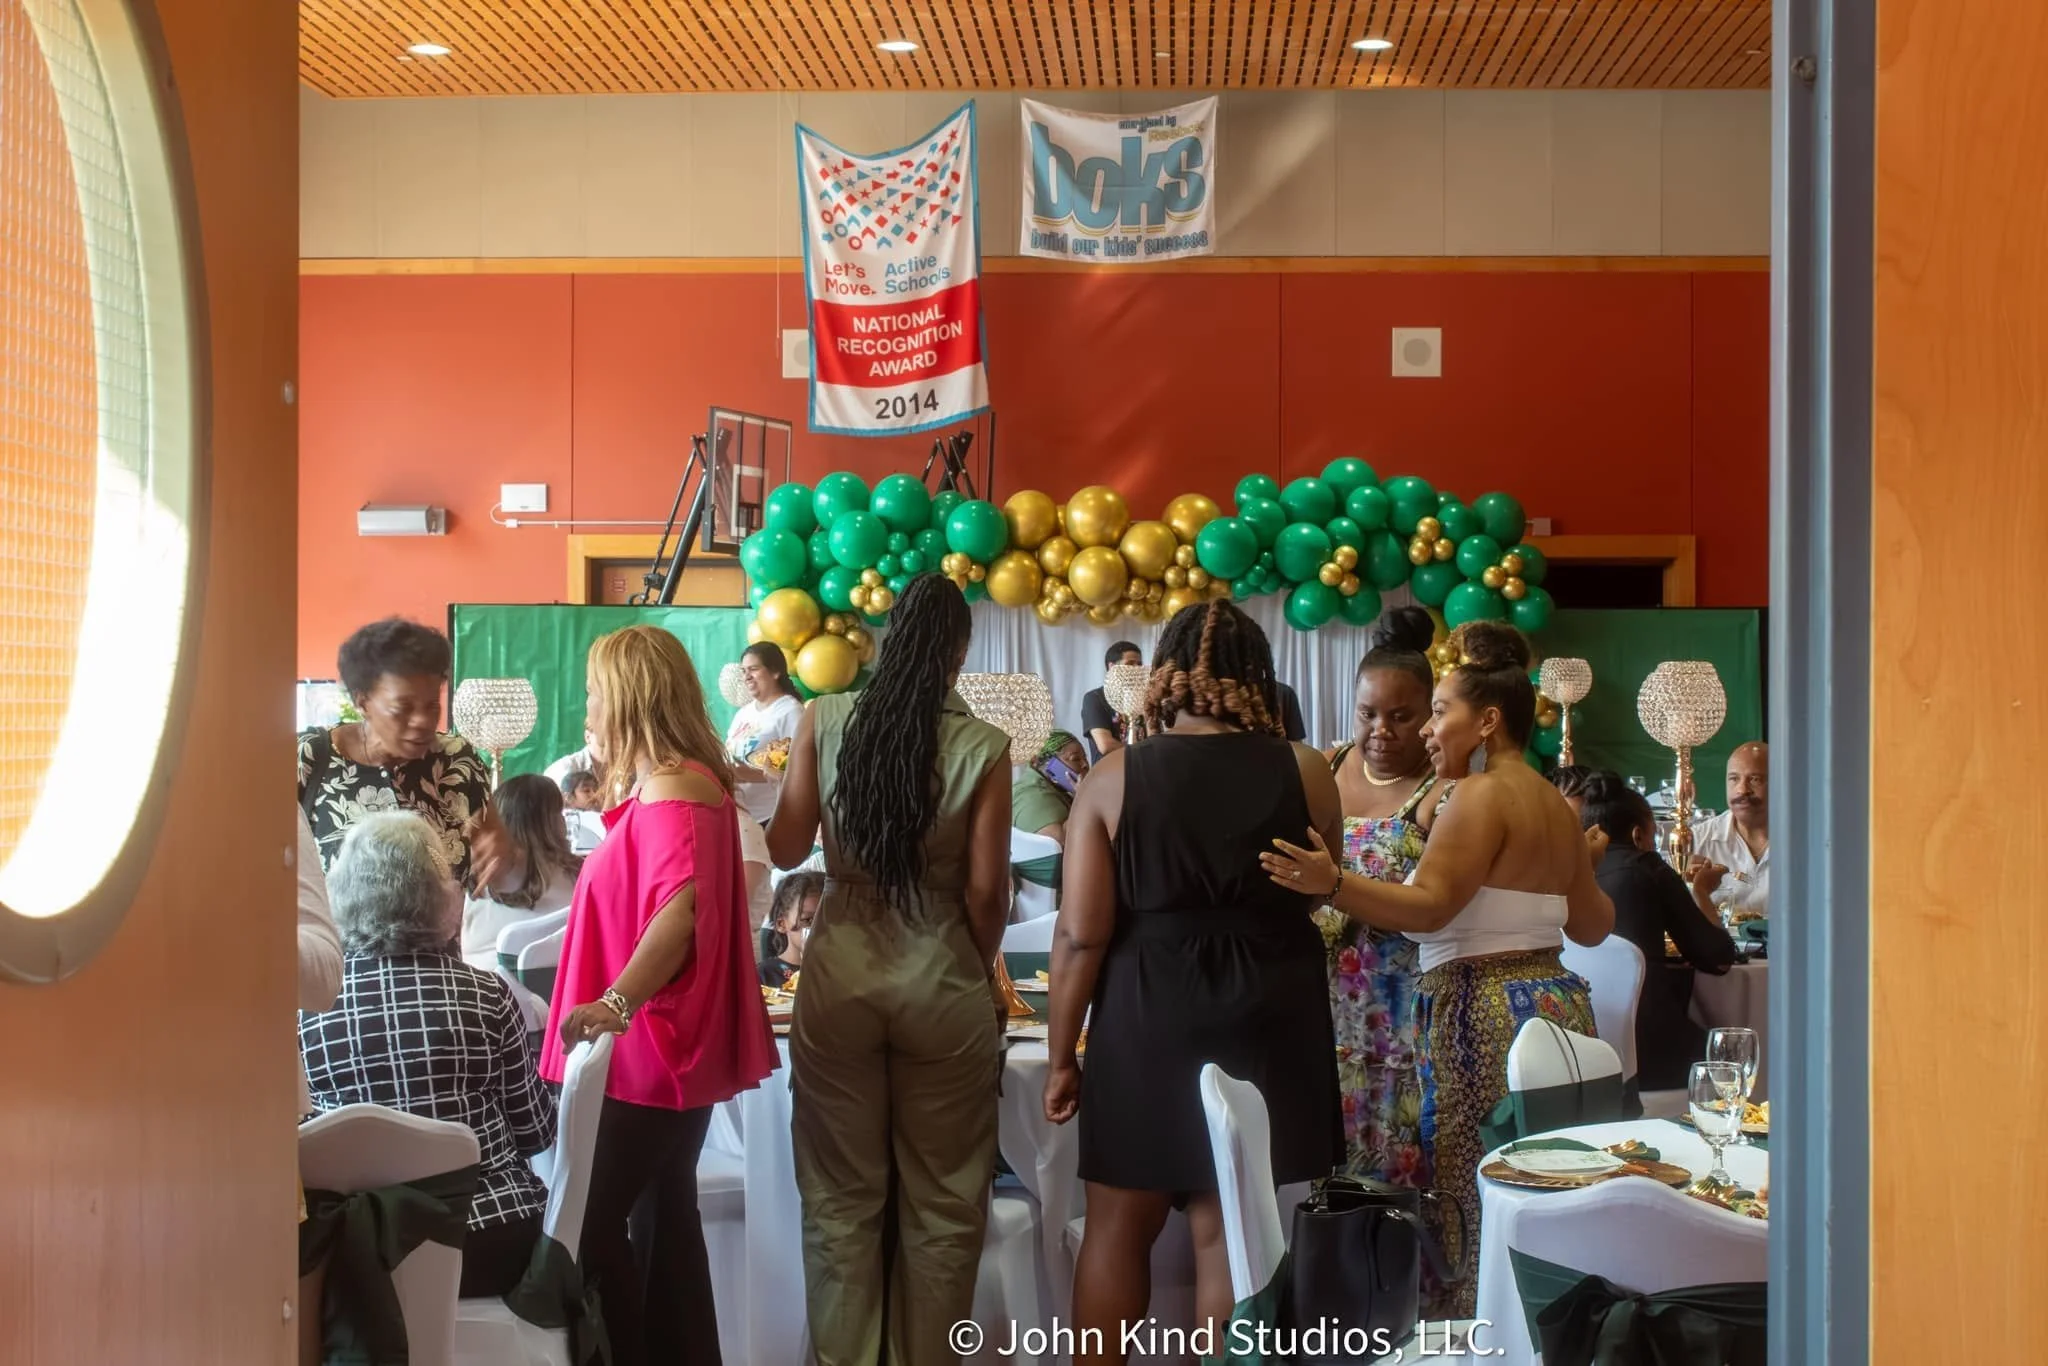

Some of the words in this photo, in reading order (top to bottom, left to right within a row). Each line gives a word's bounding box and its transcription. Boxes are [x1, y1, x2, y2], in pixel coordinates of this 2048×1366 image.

[1031, 121, 1205, 229] boks
[1031, 229, 1068, 253] build
[1072, 237, 1099, 256] our
[1104, 235, 1142, 257] kids'
[1144, 230, 1208, 255] success
[825, 260, 866, 278] Let's
[884, 255, 937, 278] Active
[885, 267, 951, 295] Schools
[853, 304, 945, 334] NATIONAL
[837, 320, 963, 356] RECOGNITION
[869, 351, 938, 377] AWARD
[875, 389, 939, 420] 2014
